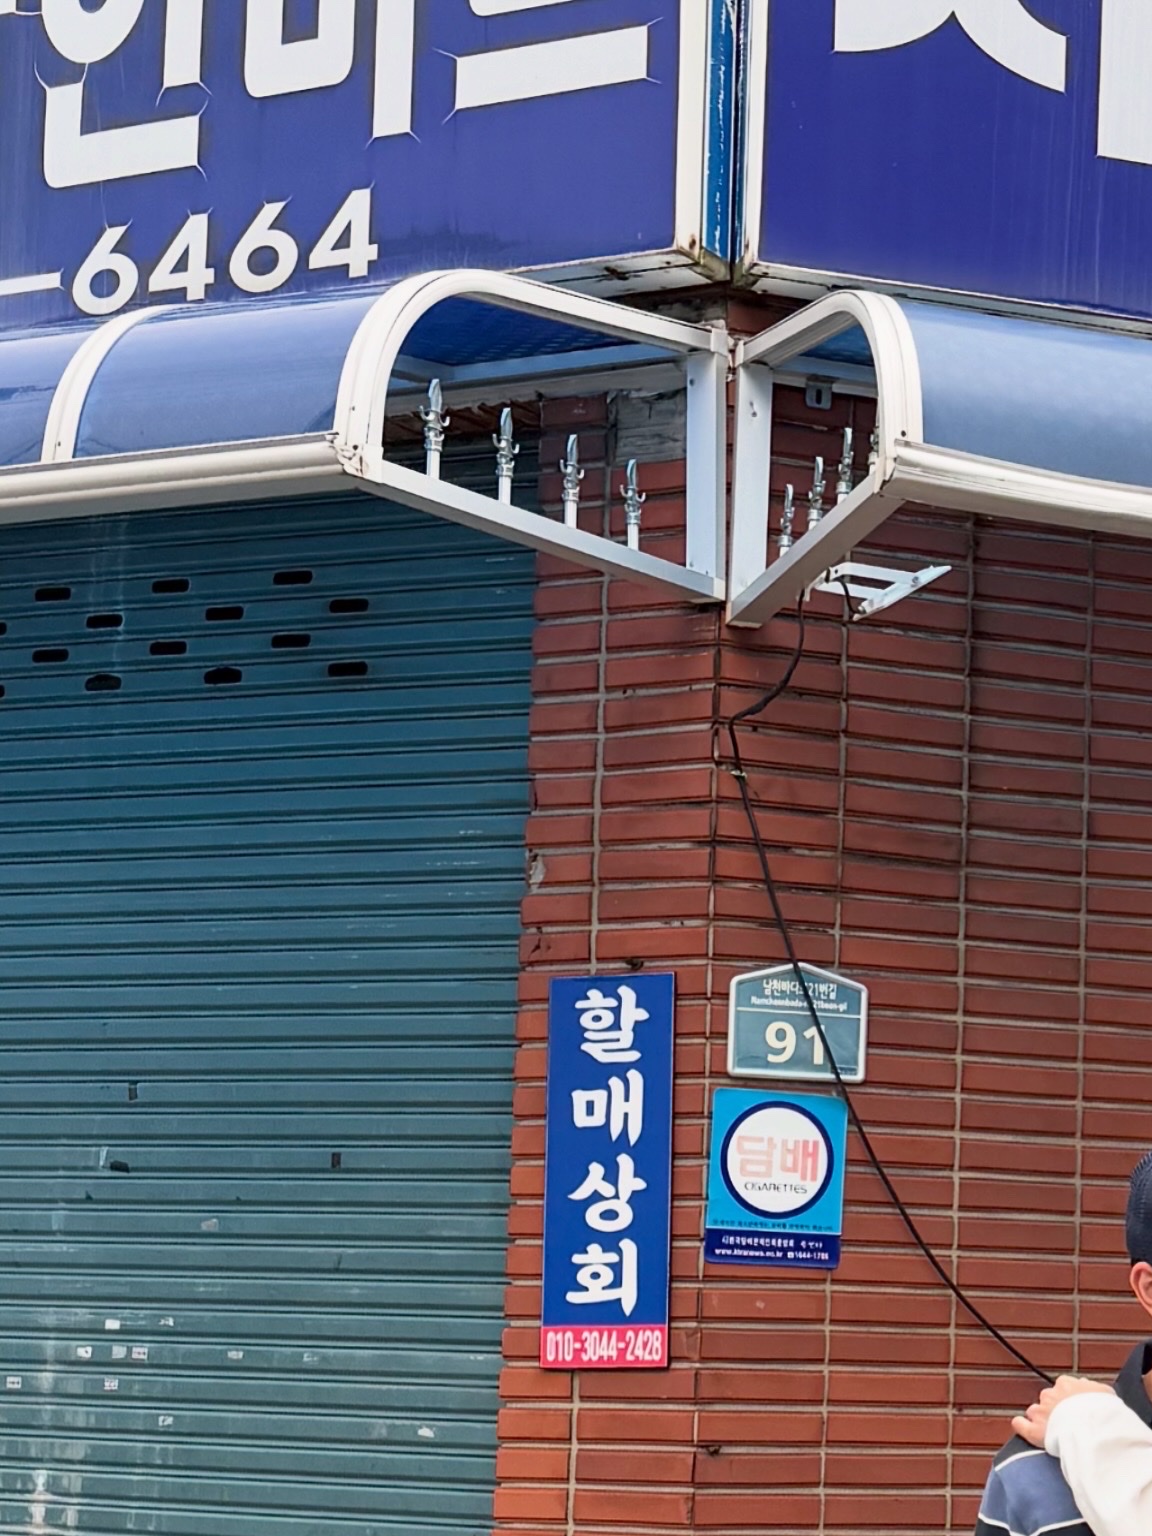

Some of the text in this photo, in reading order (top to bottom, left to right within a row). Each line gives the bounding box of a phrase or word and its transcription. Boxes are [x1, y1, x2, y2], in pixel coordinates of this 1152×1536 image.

[764, 1021, 826, 1065] 91
[565, 985, 651, 1318] 할매상회
[736, 1135, 820, 1182] 담배
[546, 1329, 663, 1362] 010-3044-2428
